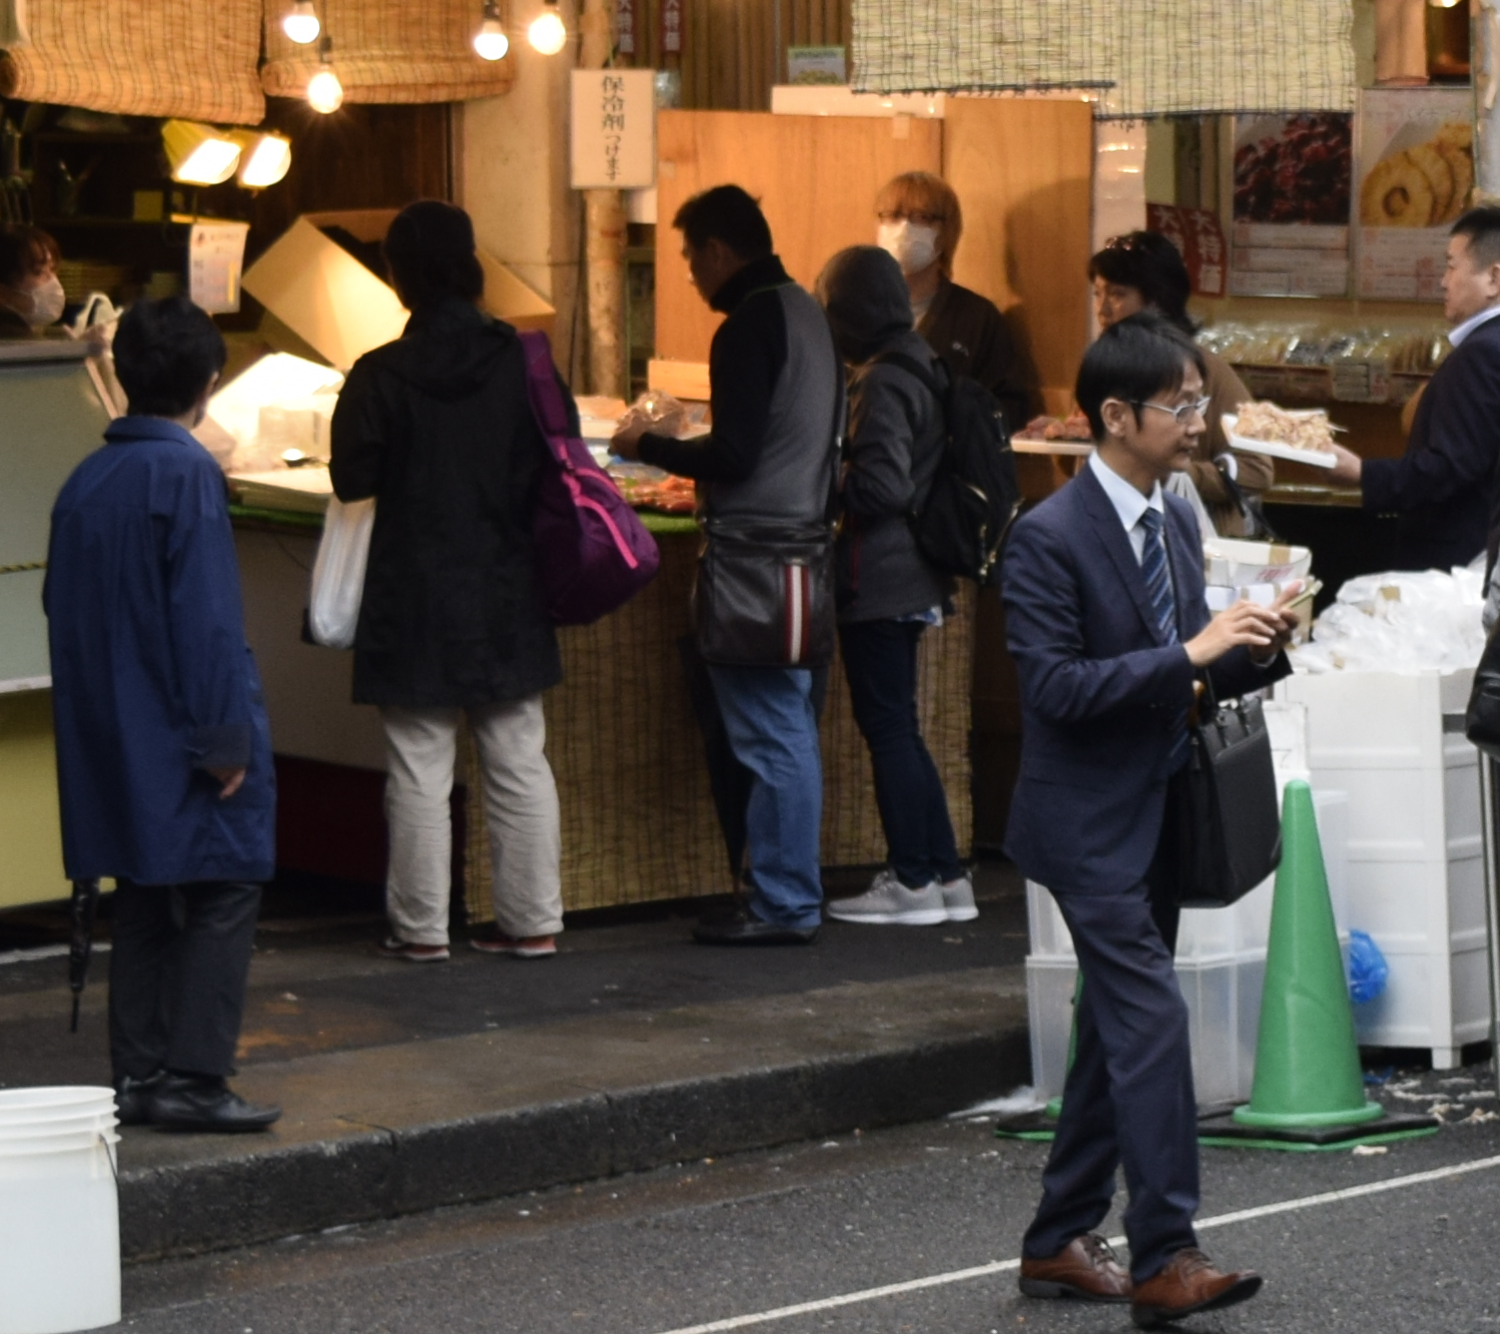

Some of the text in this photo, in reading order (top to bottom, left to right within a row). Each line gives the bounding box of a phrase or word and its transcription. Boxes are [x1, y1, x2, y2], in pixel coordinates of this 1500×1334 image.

[600, 73, 626, 182] 保冷剤つけます
